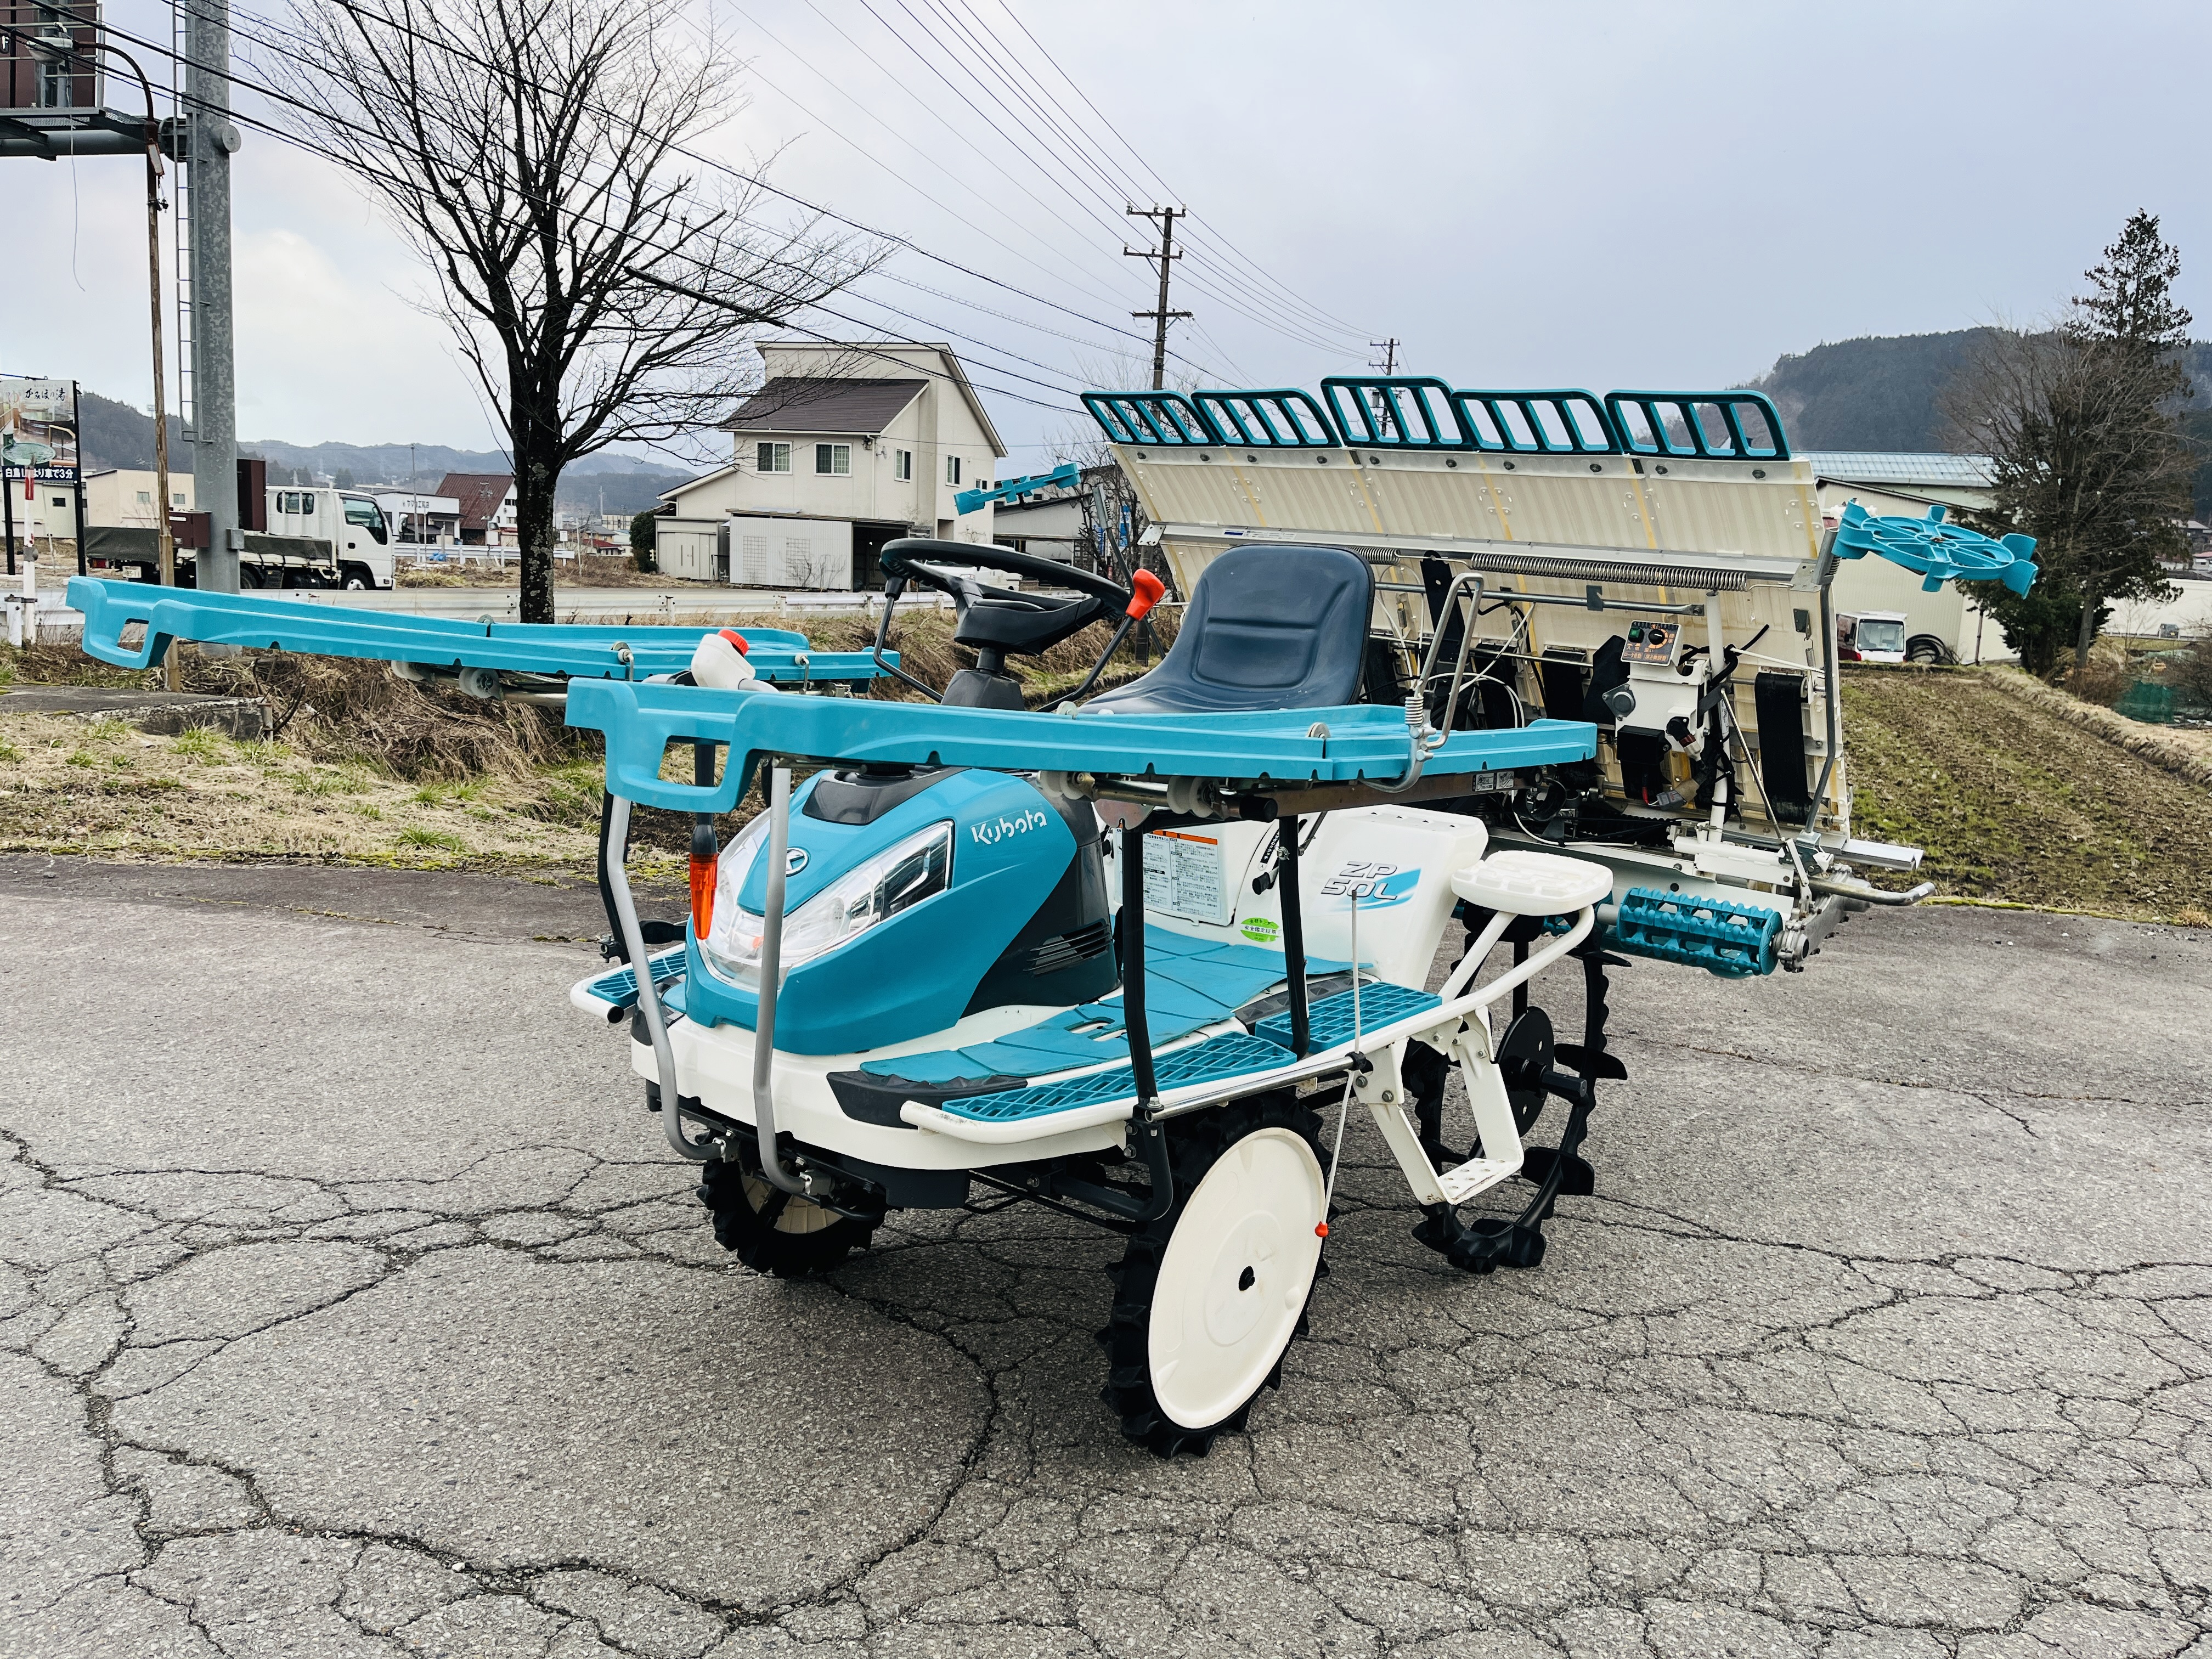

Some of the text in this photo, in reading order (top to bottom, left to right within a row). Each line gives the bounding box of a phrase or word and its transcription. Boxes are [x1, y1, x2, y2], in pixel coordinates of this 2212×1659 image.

[971, 809, 1047, 845] Kubota
[1339, 861, 1397, 878] ZP
[1321, 878, 1398, 900] 50L
